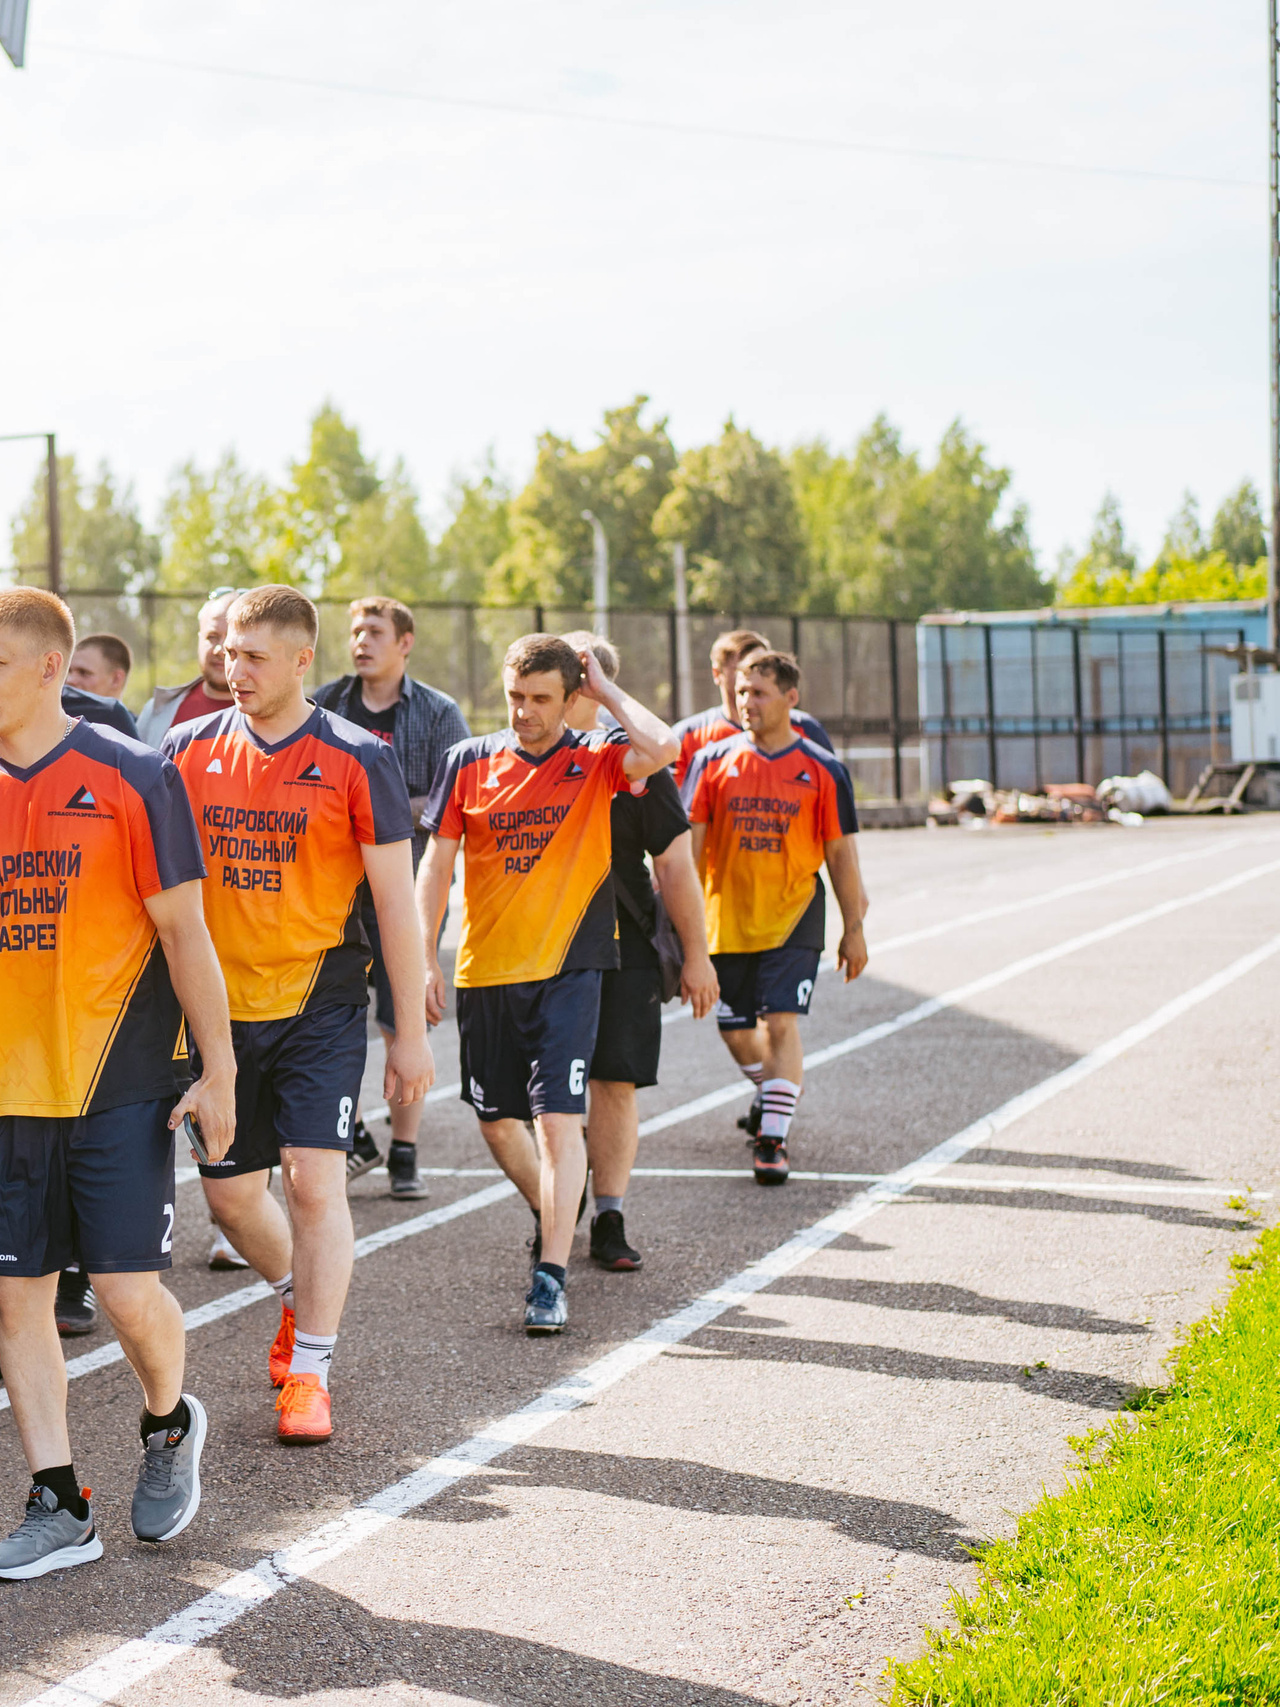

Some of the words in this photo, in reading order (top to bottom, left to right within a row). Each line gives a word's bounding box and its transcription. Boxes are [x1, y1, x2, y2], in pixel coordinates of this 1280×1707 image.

[202, 806, 308, 836] КЕДРОВСКИЙ
[488, 798, 575, 833] КЕДРОВСКИ
[208, 835, 297, 863] УГОЛЬНЫЙ
[739, 836, 782, 854] РАЗРЕЗ
[222, 865, 282, 893] РАЗРЕЗ
[505, 854, 542, 875] РАЗР
[568, 1058, 586, 1096] 6
[336, 1096, 353, 1139] 8
[160, 1203, 175, 1254] 2
